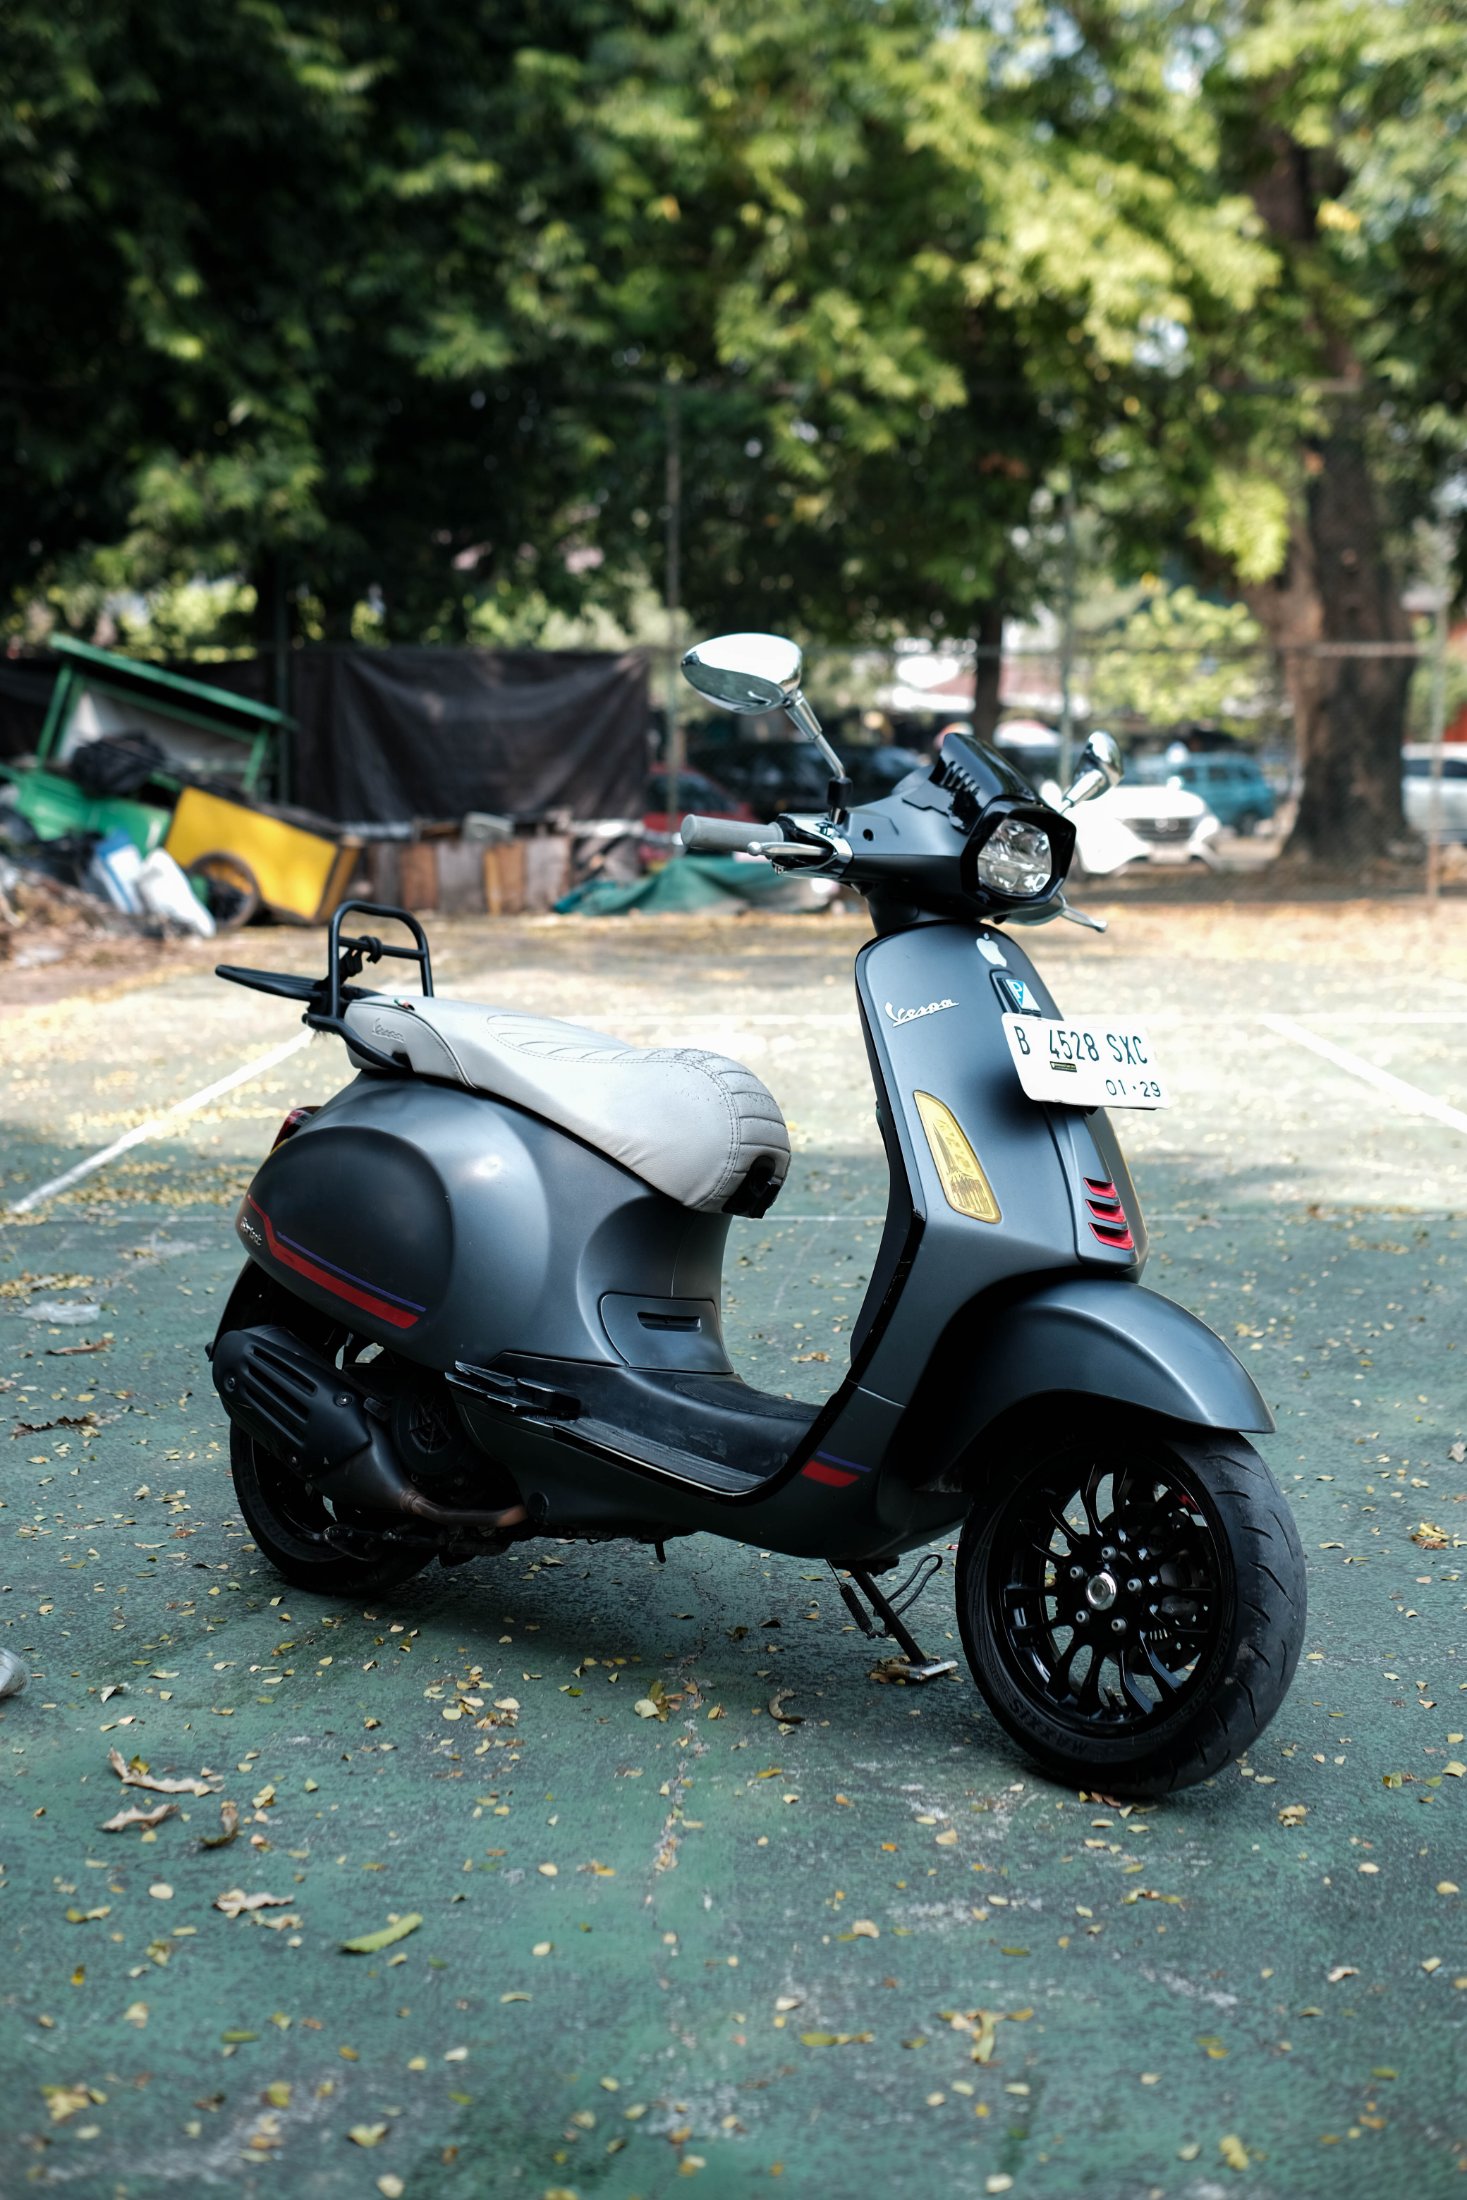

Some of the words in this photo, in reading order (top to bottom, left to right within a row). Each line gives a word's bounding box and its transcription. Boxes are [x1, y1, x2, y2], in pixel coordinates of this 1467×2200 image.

[884, 999, 959, 1028] Vespa
[1014, 1026, 1031, 1055] B
[1049, 1029, 1100, 1061] 4528
[1106, 1033, 1148, 1065] SXC
